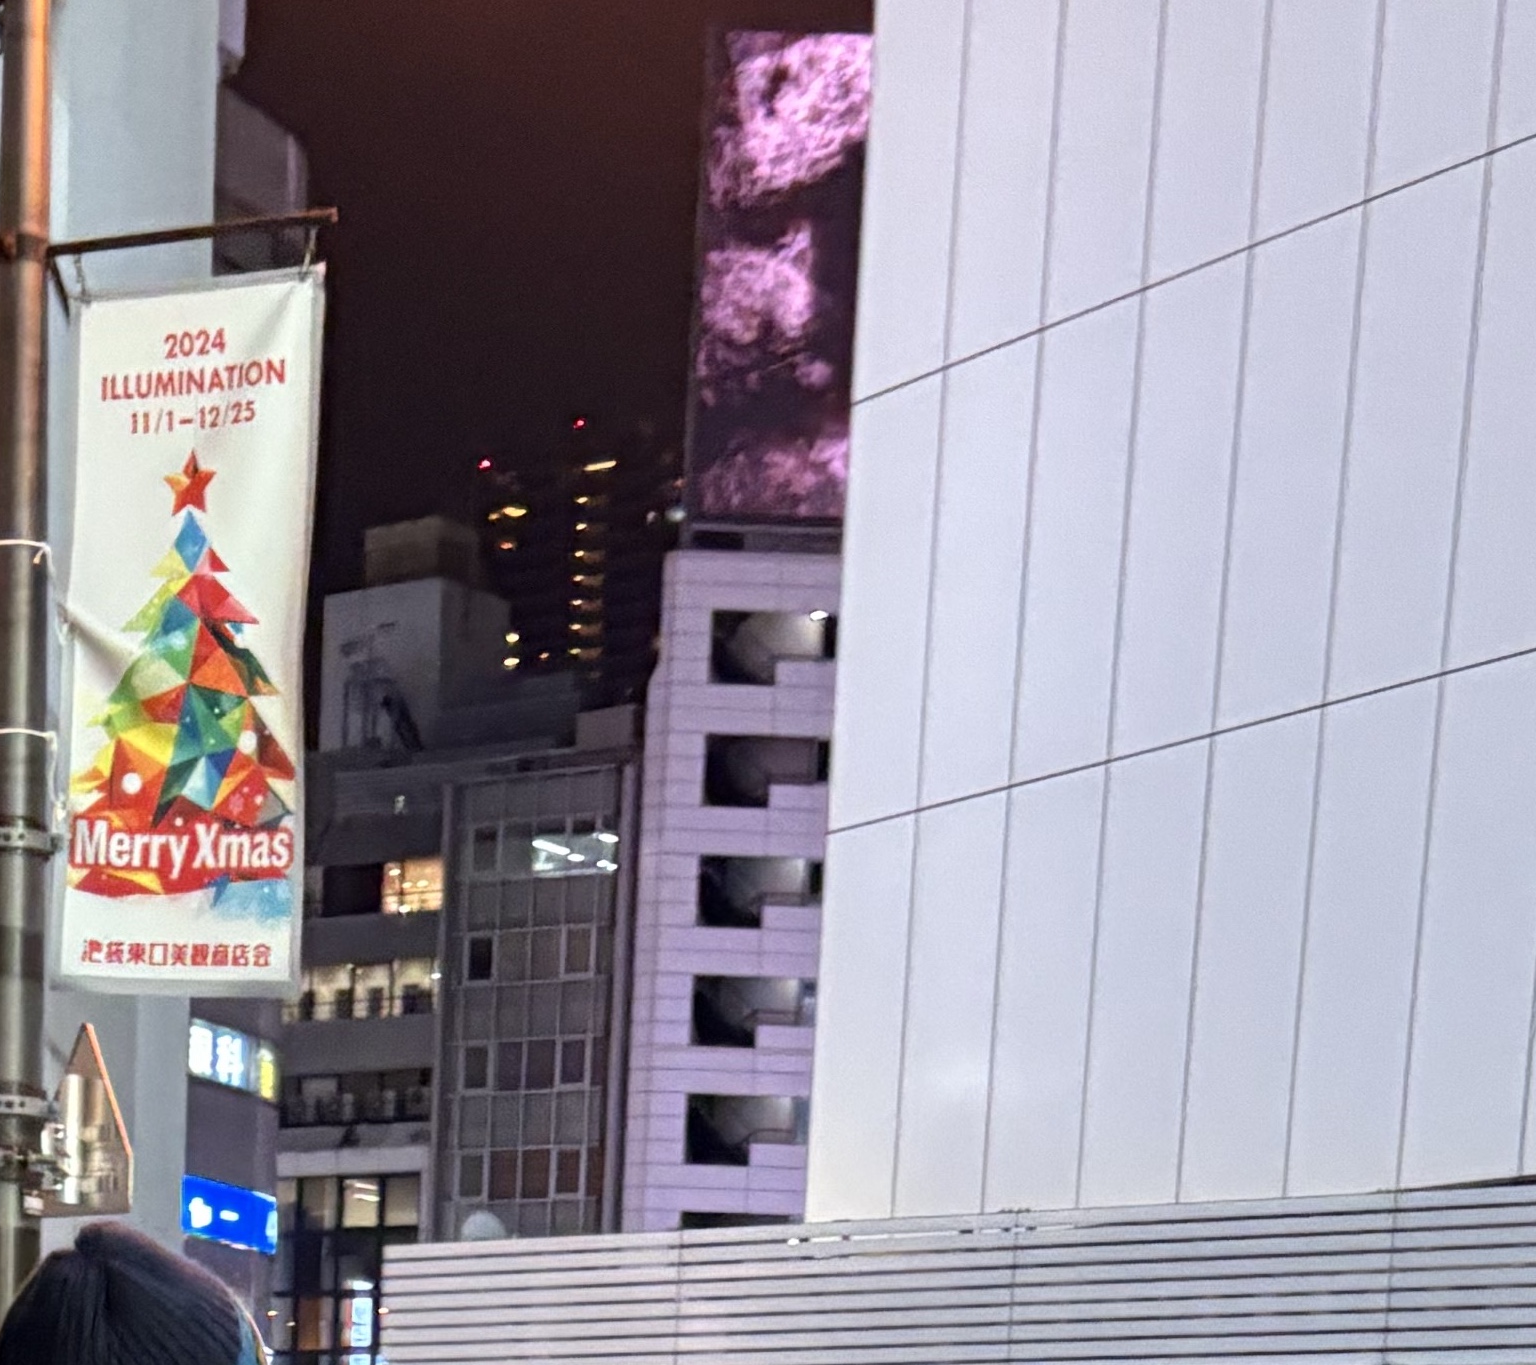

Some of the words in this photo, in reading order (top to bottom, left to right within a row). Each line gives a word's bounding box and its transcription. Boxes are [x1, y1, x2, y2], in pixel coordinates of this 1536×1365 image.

[163, 327, 227, 360] 2024
[101, 359, 285, 401] ILLUMINATION
[73, 818, 190, 880] Merry
[191, 822, 292, 869] Xmas
